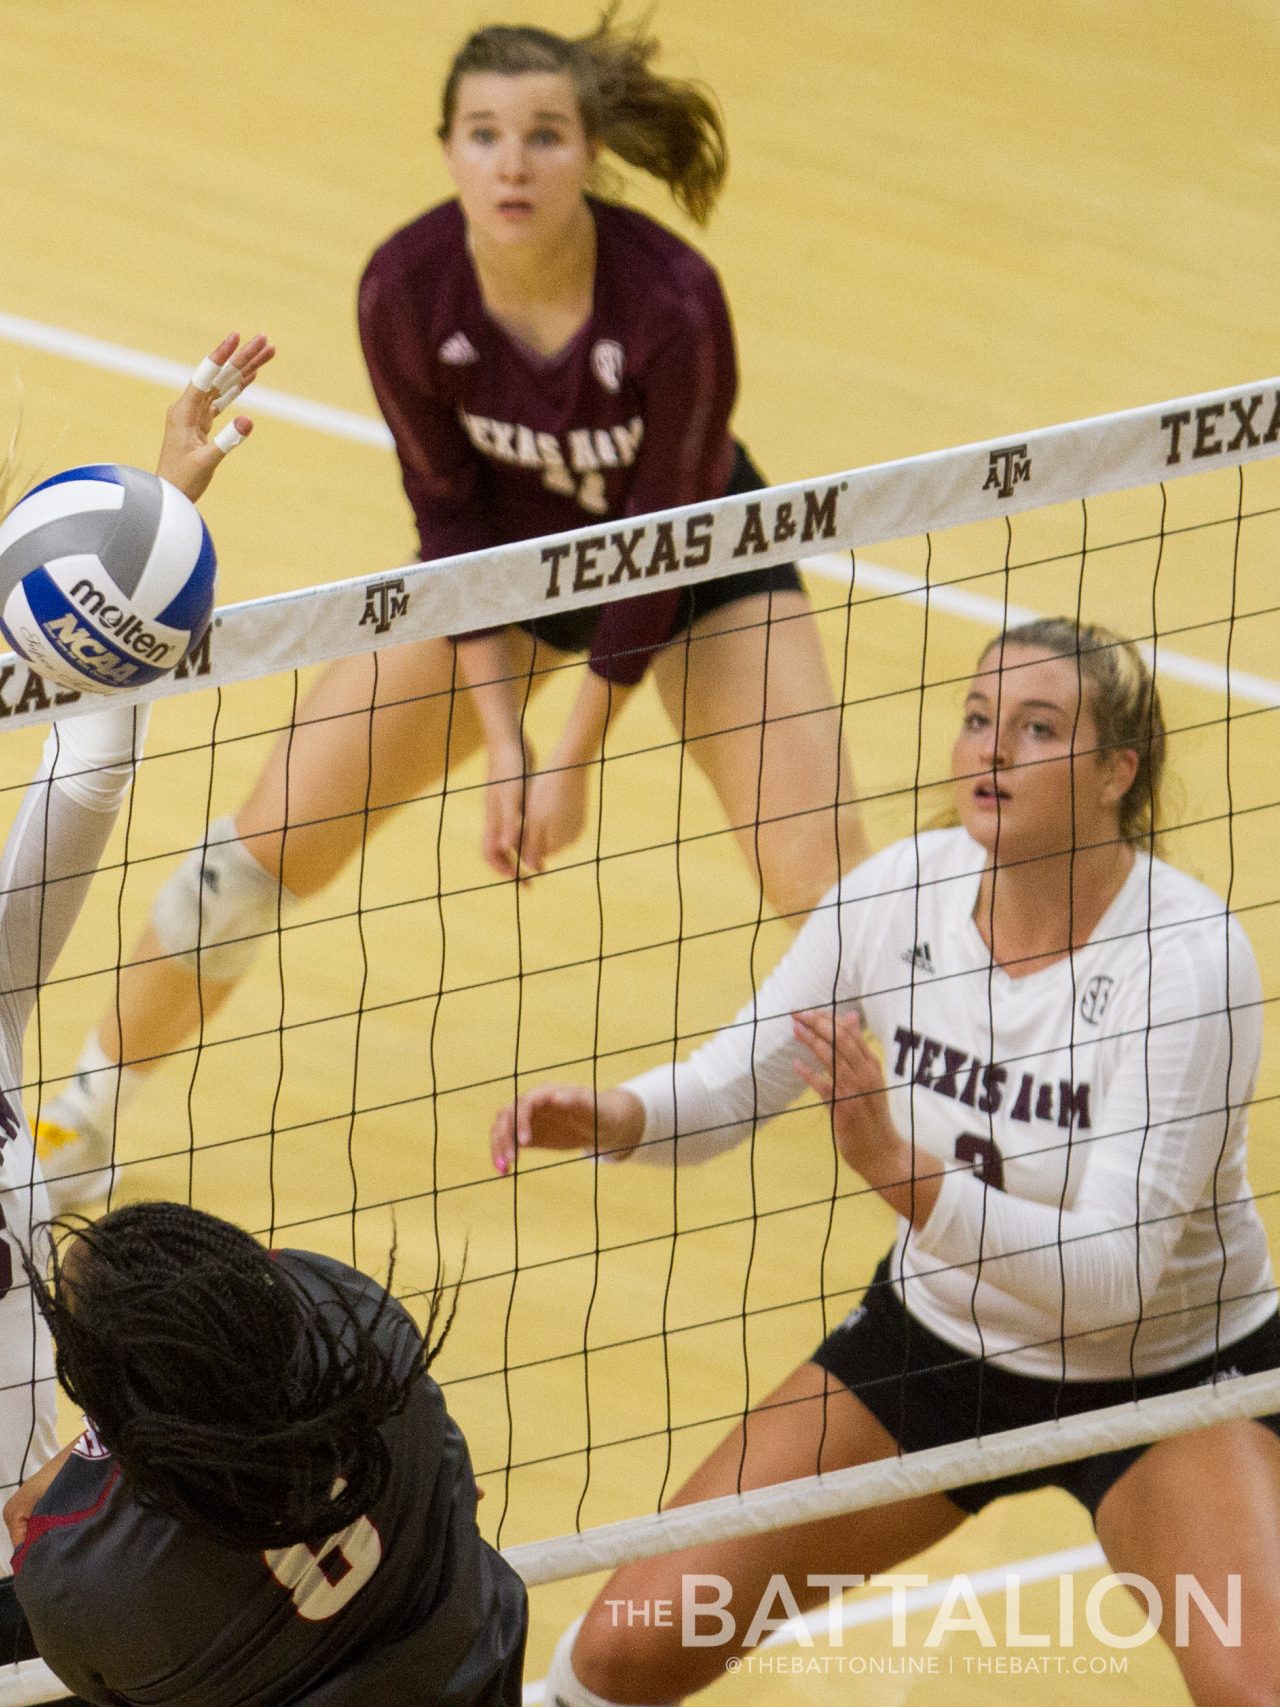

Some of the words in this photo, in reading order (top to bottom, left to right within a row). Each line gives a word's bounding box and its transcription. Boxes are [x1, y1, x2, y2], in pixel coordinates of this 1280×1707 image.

[541, 512, 715, 599] TEXAS
[732, 485, 839, 558] A&M
[44, 613, 139, 684] NCAA
[69, 579, 170, 662] molten
